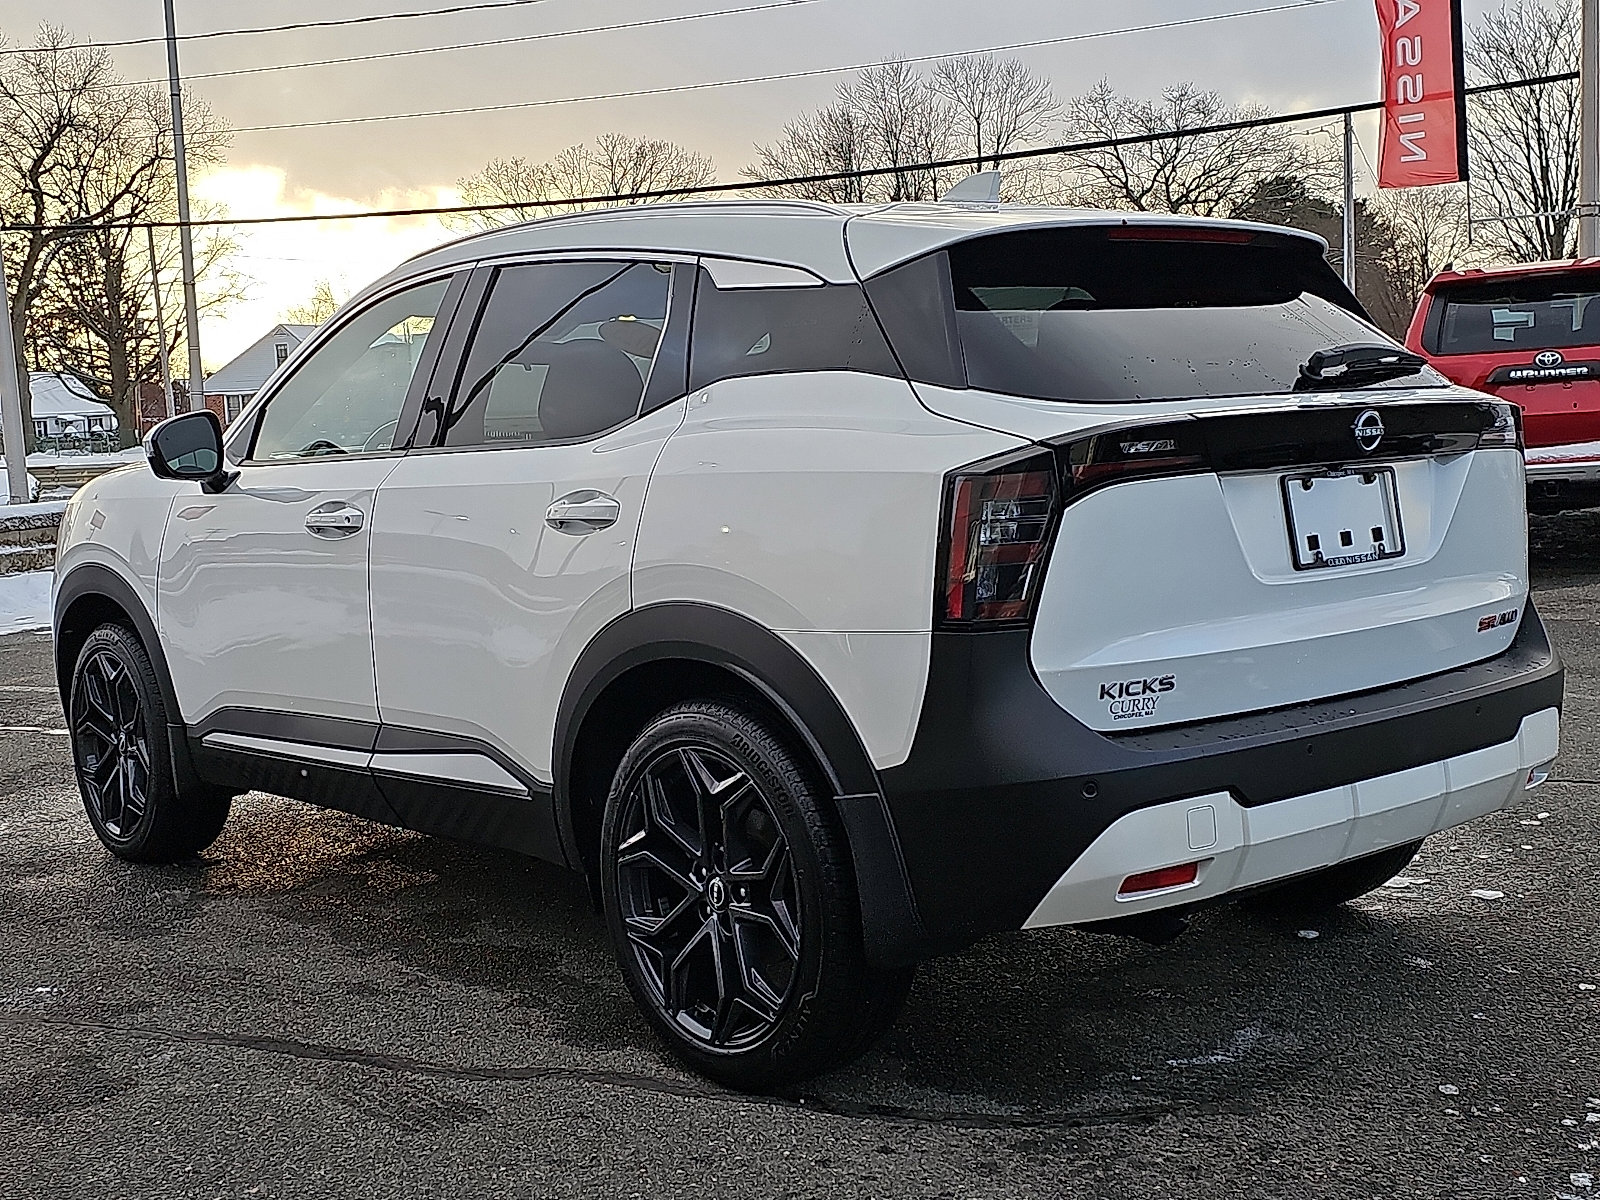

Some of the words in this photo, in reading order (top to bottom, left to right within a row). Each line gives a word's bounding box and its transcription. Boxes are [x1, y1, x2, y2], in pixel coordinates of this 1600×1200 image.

[1355, 428, 1385, 437] NISSAN
[1346, 553, 1379, 564] NISSAN
[1099, 675, 1175, 700] KICKS
[1109, 696, 1160, 714] CURRY
[729, 732, 796, 818] BRIDGESTON
